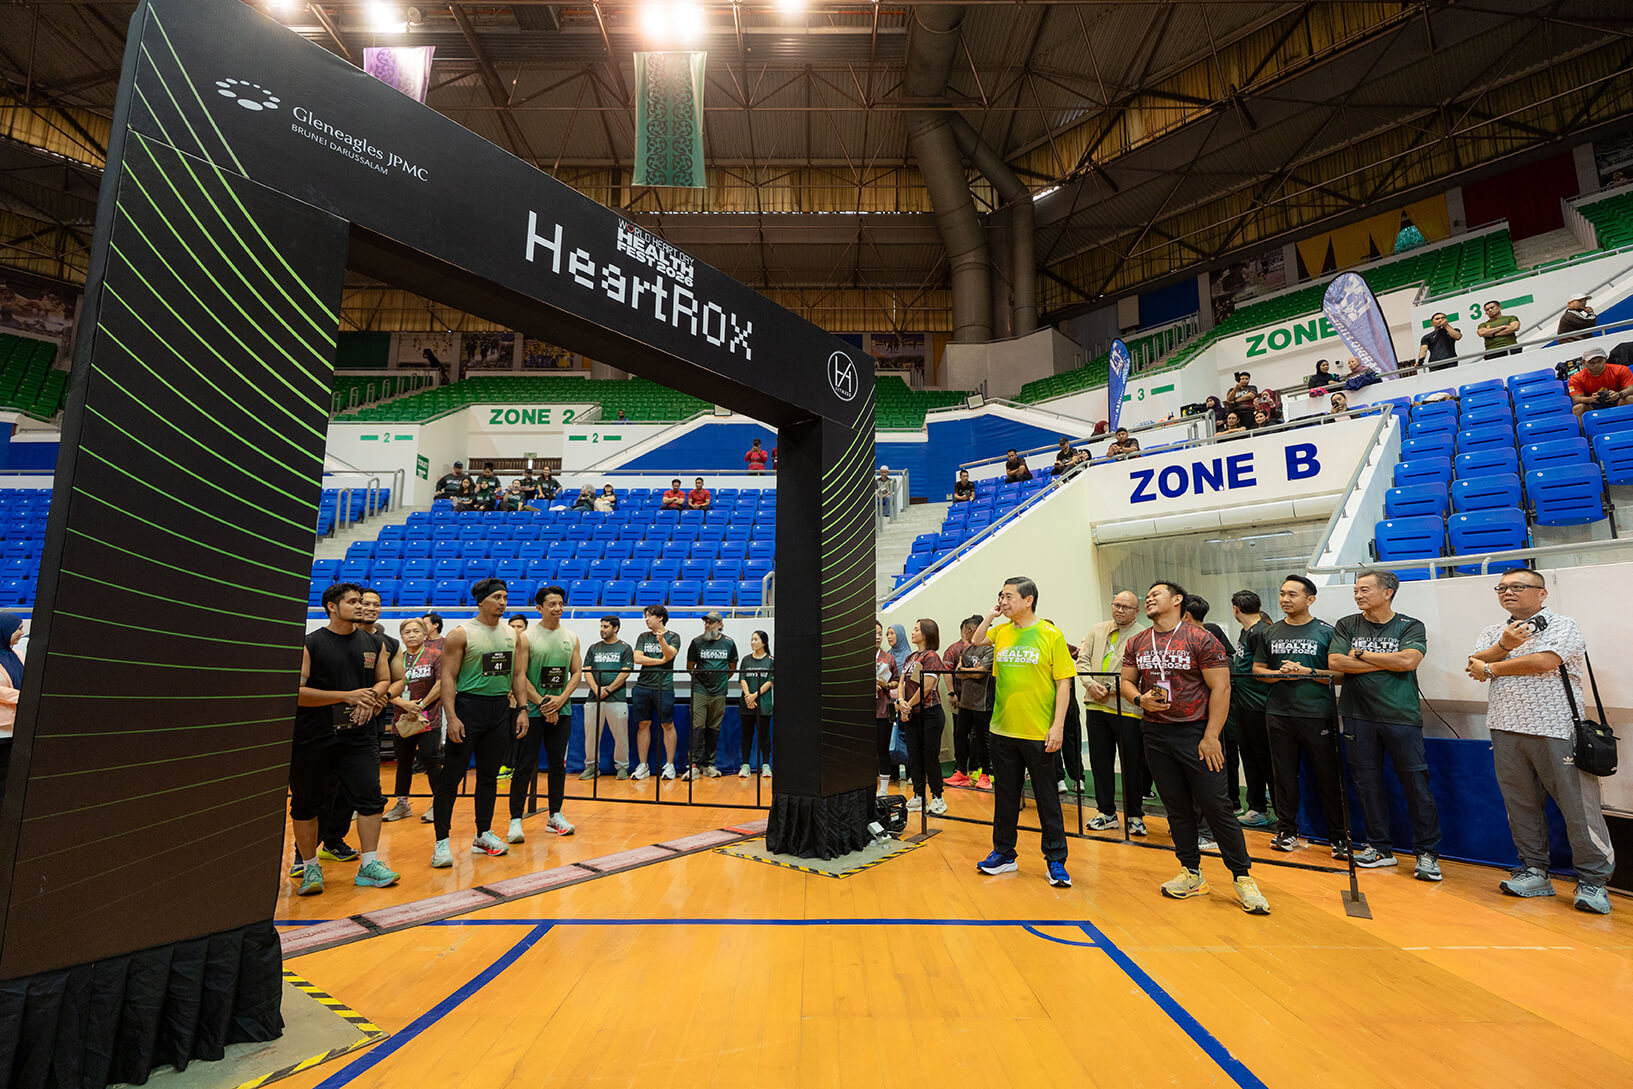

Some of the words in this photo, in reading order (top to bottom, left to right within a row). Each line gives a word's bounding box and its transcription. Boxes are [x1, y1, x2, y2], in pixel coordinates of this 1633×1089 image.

[291, 123, 328, 146] BRUNEI
[329, 142, 388, 175] DARUSSALAM
[292, 106, 384, 160] Gleneagles
[387, 152, 429, 182] JPMC
[617, 227, 694, 278] HEALTH
[616, 240, 656, 267] FEST
[656, 262, 694, 287] 2026
[1469, 303, 1482, 320] 3
[1137, 388, 1145, 401] 3
[489, 408, 552, 425] ZONE
[562, 408, 575, 425] 2
[383, 432, 391, 443] 2
[592, 432, 599, 443] 2
[1129, 452, 1257, 504] ZONE
[1284, 442, 1321, 481] B
[1271, 642, 1318, 651] HEALTH
[1351, 640, 1400, 649] HEALTH
[494, 662, 503, 670] 41
[1136, 654, 1191, 665] HEALTH
[551, 675, 560, 683] 42
